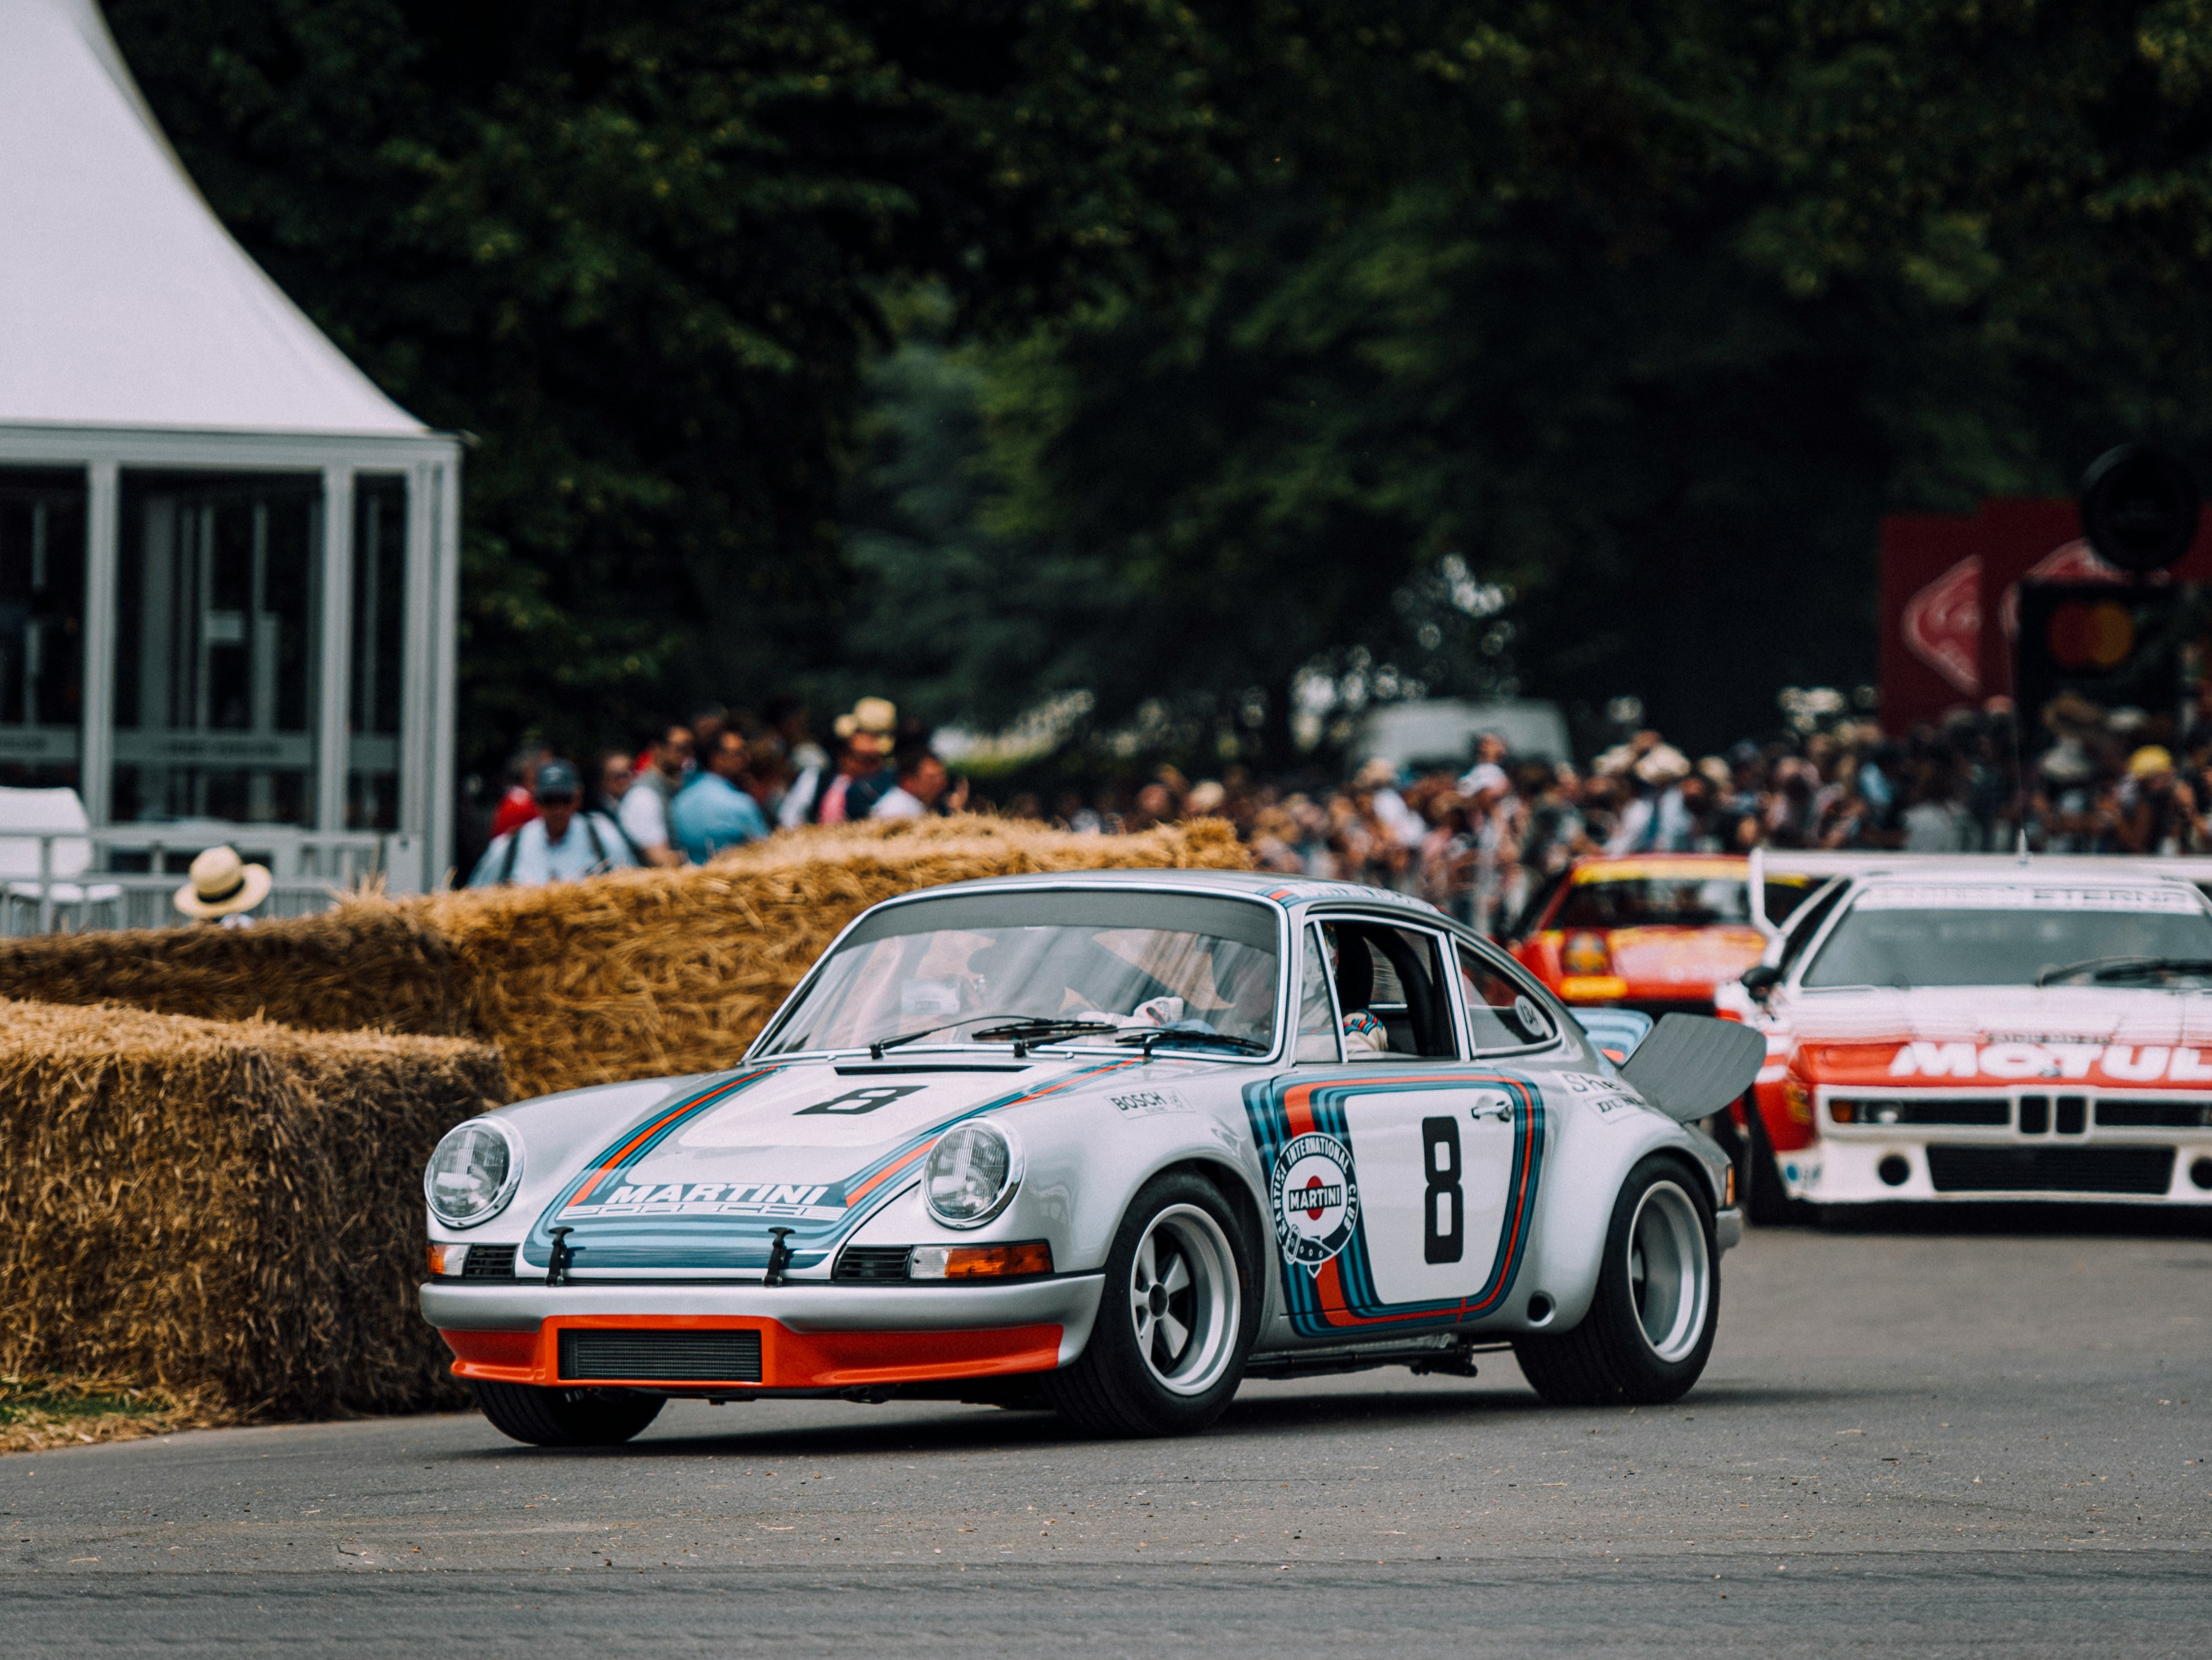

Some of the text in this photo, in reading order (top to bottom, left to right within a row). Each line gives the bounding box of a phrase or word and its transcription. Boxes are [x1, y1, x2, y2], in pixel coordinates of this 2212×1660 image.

[1889, 1041, 2212, 1082] MOTUL
[792, 1086, 929, 1115] 8
[1110, 1092, 1167, 1111] BOSCH
[605, 1184, 829, 1205] MARTINI
[1286, 1137, 1349, 1174] INTERNATIONAL
[1343, 1183, 1357, 1231] CLUB
[1290, 1186, 1341, 1211] MARTINI
[1422, 1116, 1463, 1265] 8
